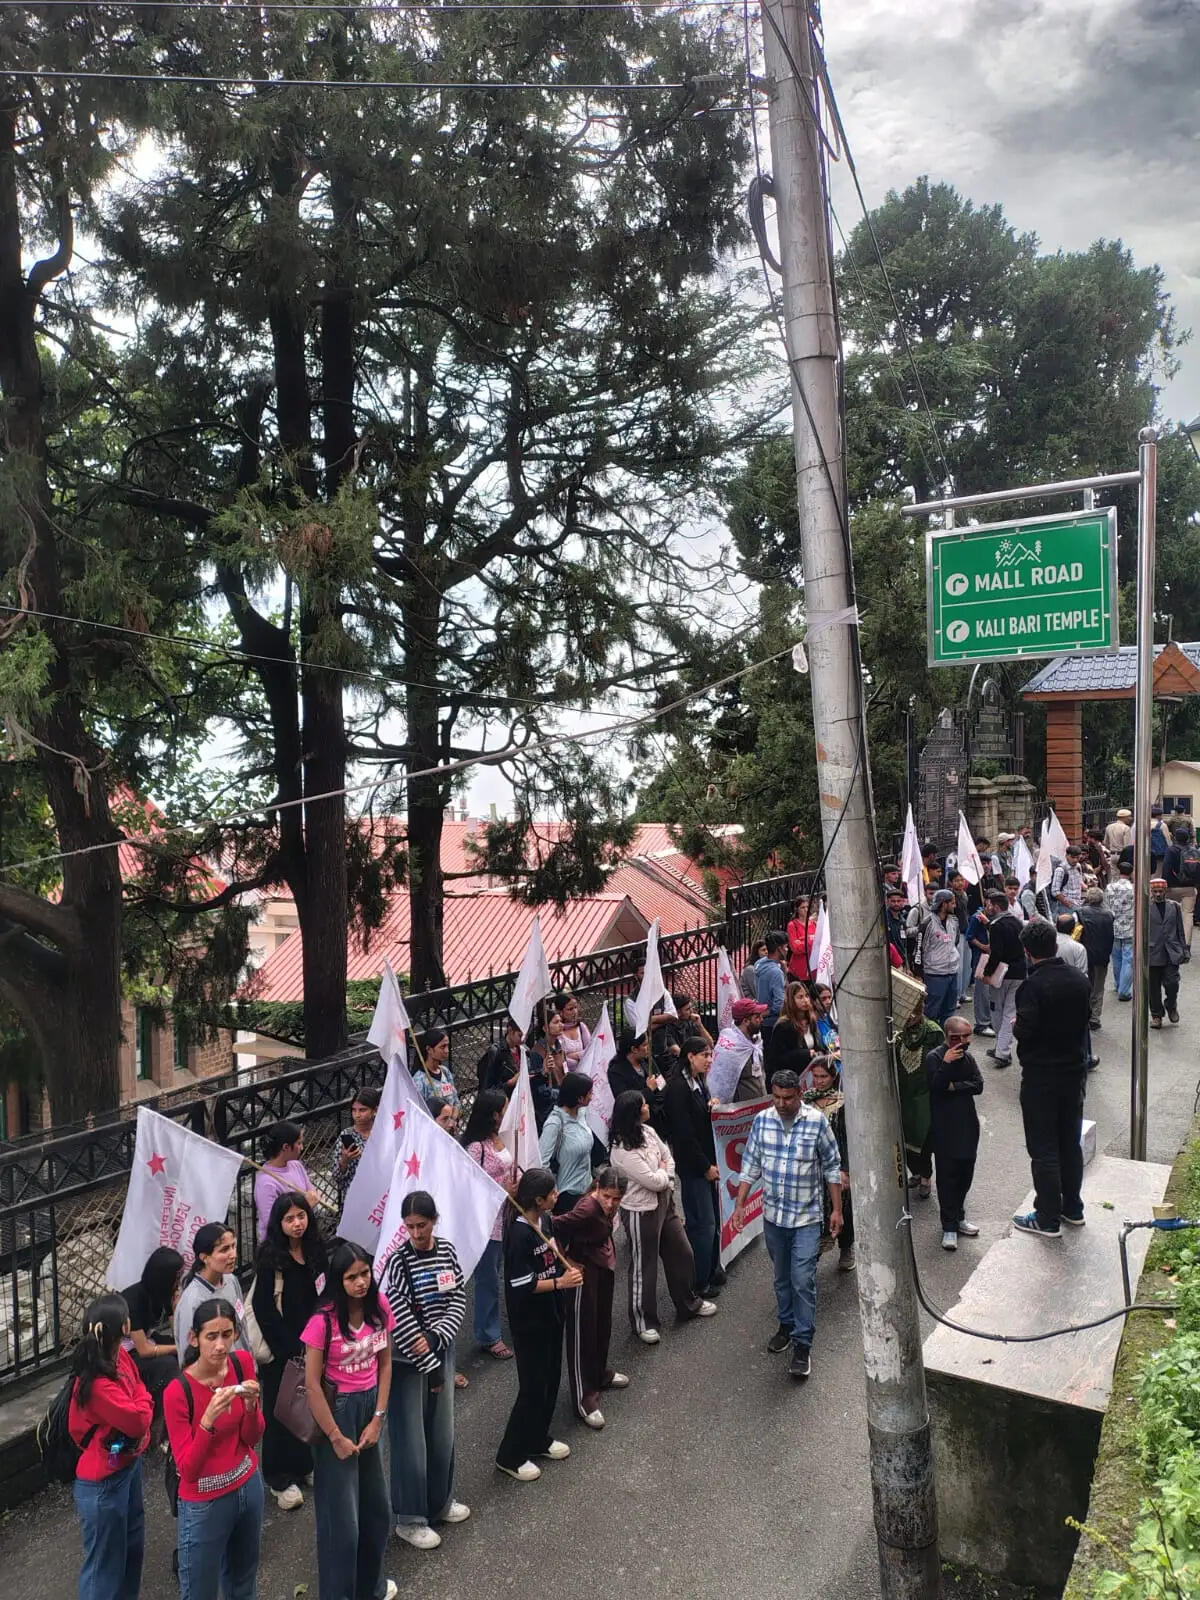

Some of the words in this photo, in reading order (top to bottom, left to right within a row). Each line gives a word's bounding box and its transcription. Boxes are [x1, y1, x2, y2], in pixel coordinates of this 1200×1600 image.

[975, 570, 1024, 592] MALL
[1031, 562, 1083, 586] ROAD
[976, 617, 1005, 638] KALI
[1009, 614, 1041, 635] BARI
[1044, 608, 1099, 631] TEMPLE
[439, 1273, 456, 1286] SFI
